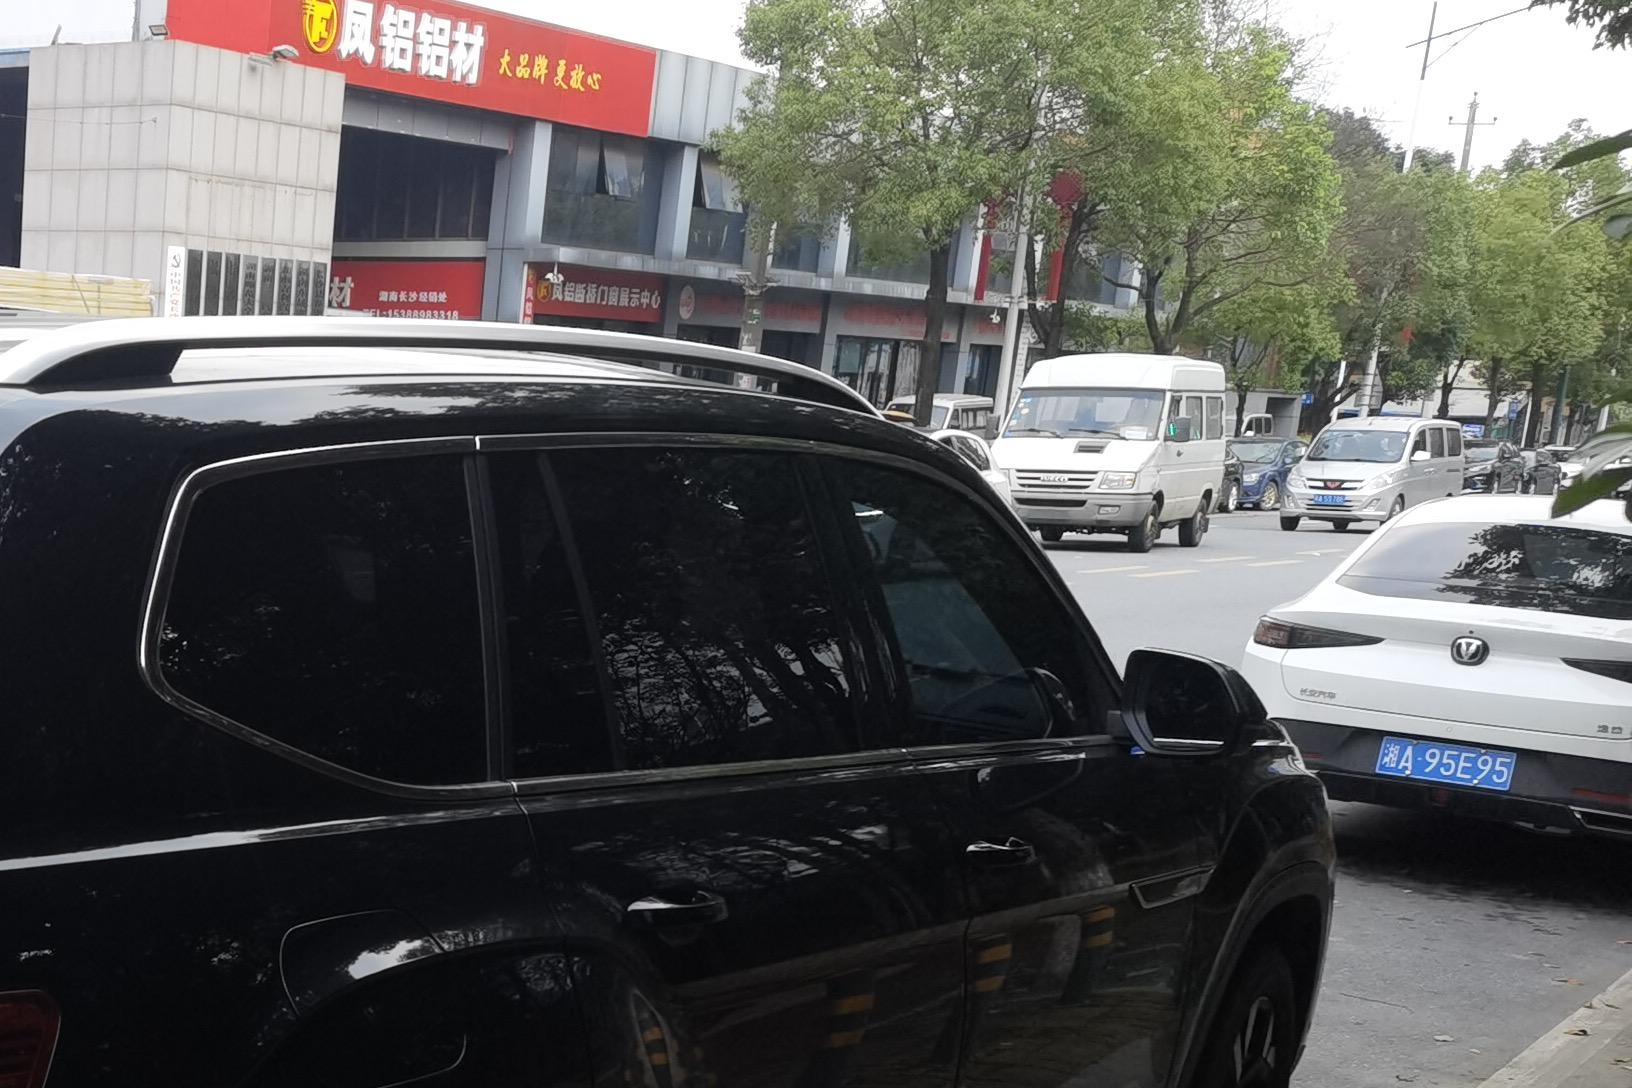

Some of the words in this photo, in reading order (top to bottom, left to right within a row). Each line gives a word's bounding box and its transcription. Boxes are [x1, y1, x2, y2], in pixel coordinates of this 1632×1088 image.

[337, 0, 485, 85] 凤铝铝材
[499, 48, 549, 84] 大品牌
[554, 60, 602, 92] 更放心
[329, 276, 354, 308] 材
